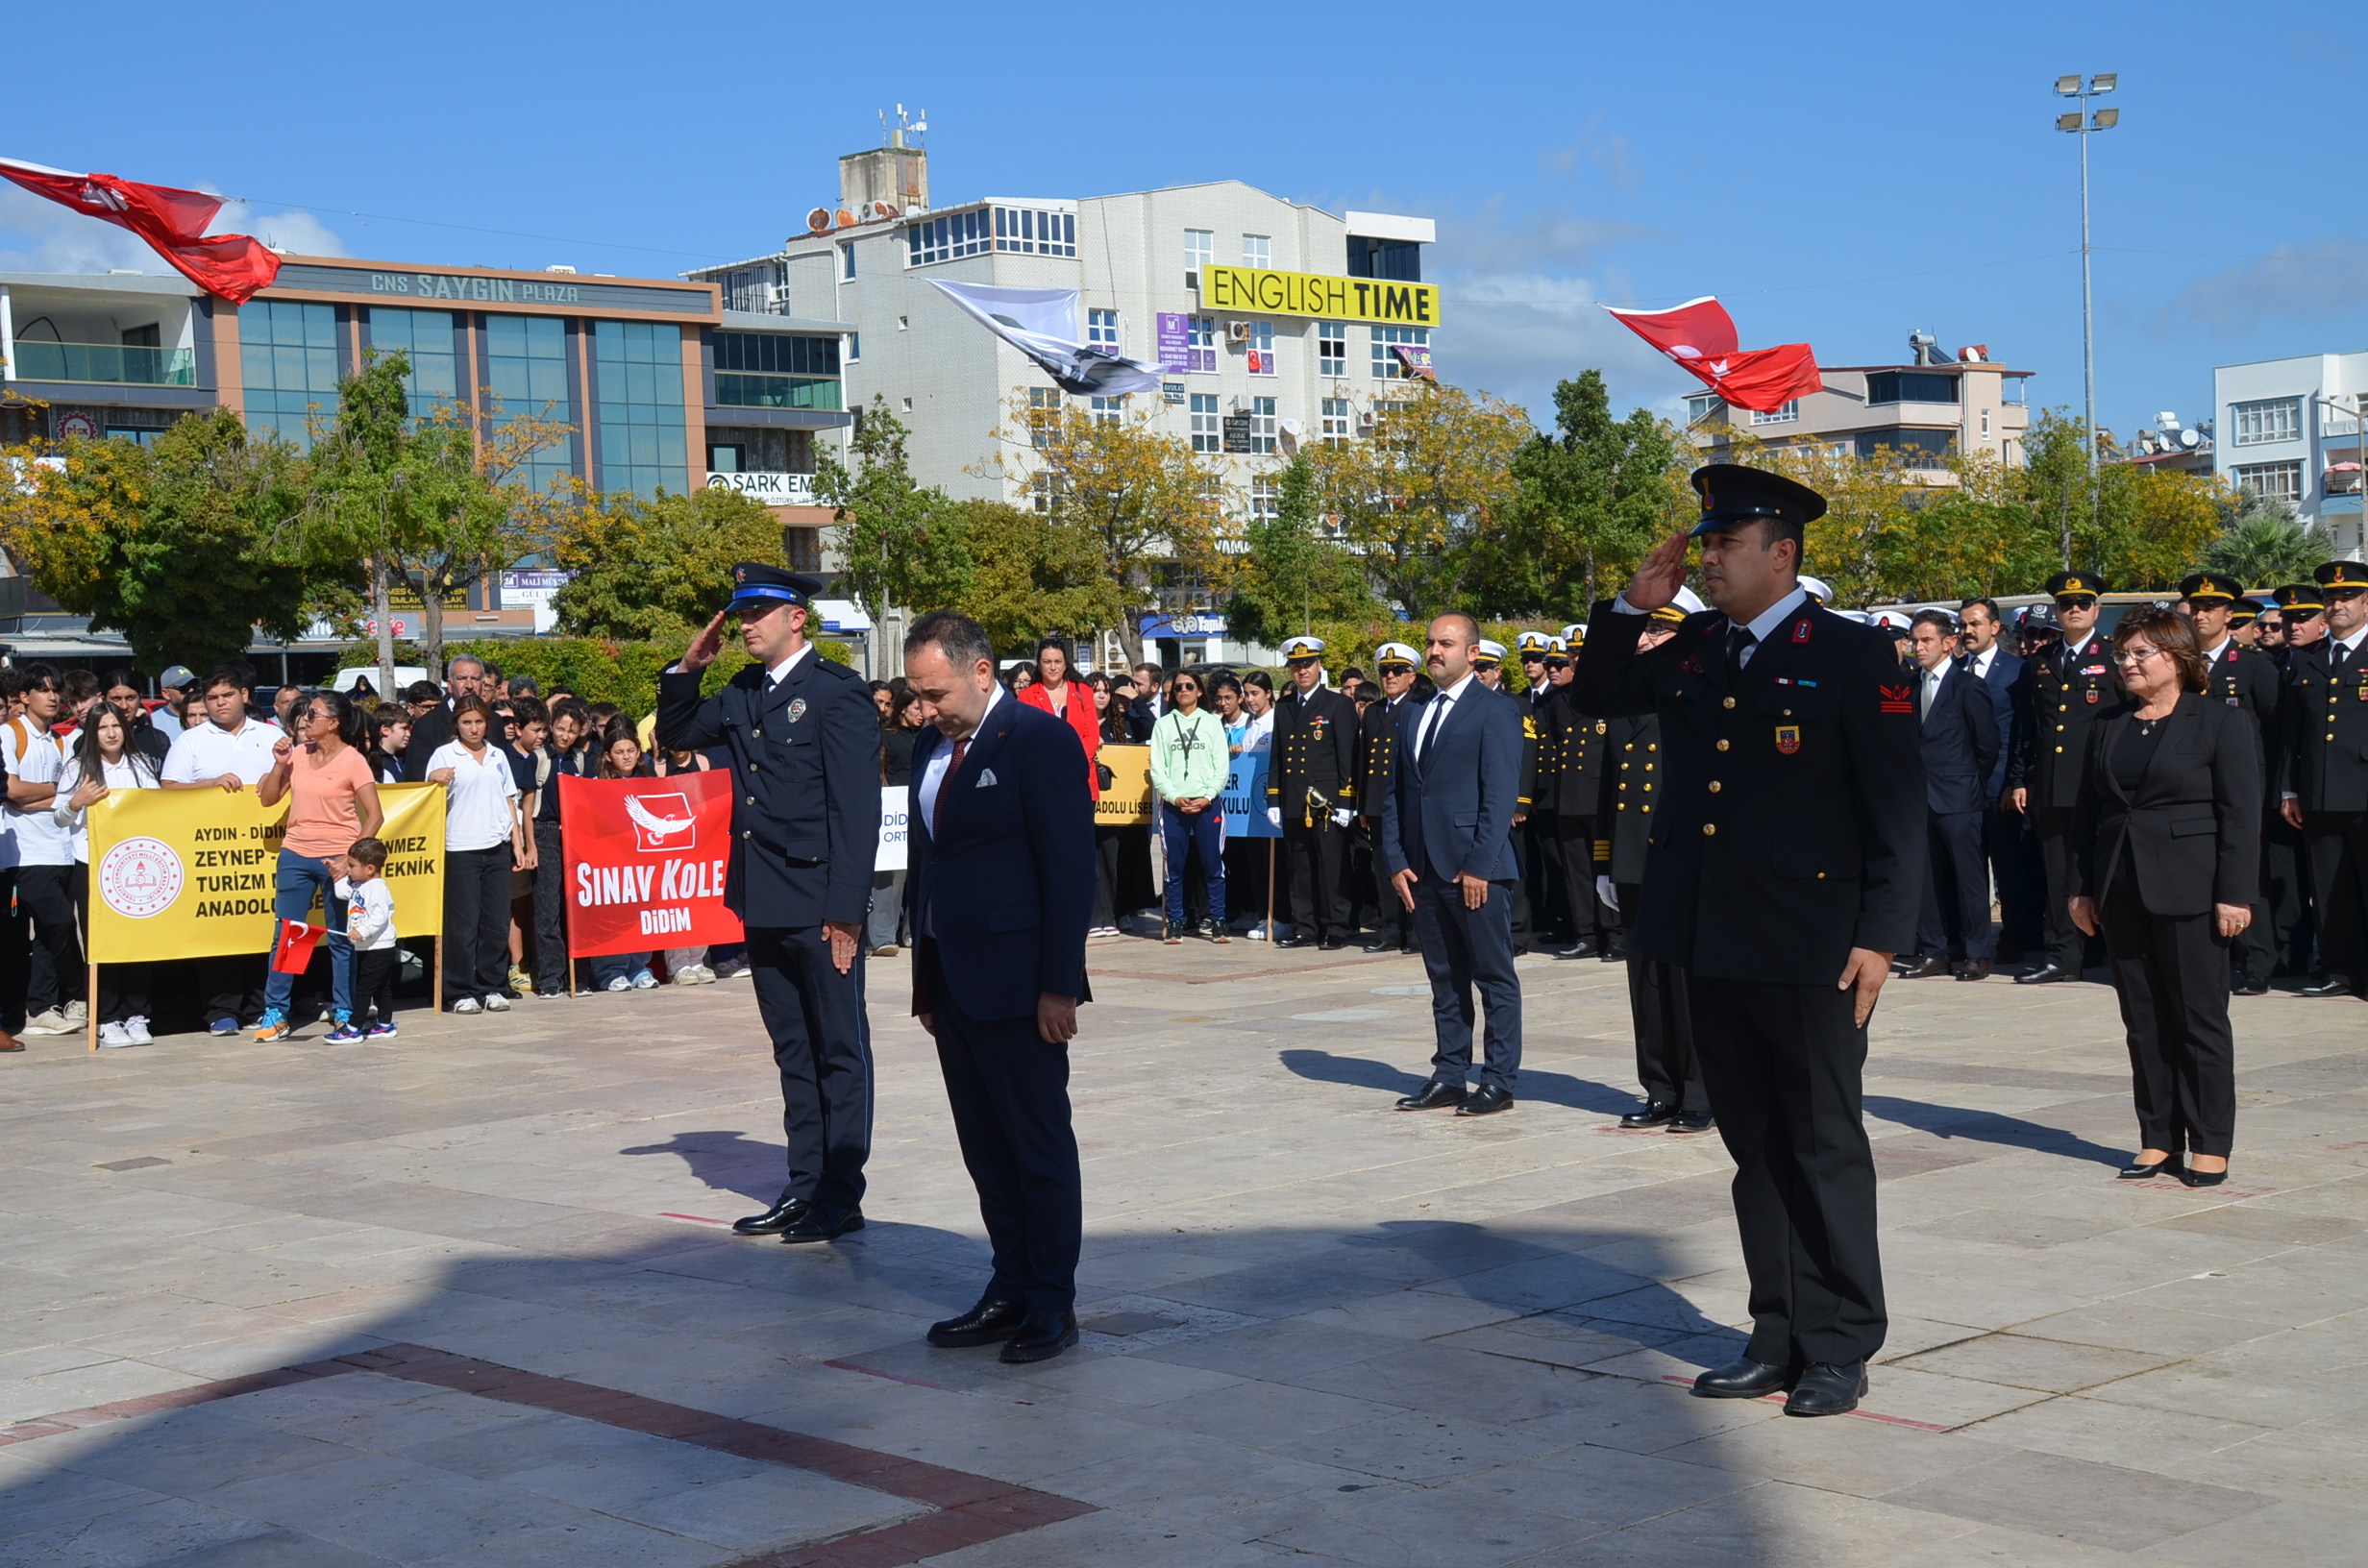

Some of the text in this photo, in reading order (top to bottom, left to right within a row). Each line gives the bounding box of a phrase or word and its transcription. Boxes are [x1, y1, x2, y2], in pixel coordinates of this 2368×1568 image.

[372, 274, 579, 303] CNS SAYGIN PLAZA
[1214, 269, 1430, 322] ENGLISH TIME
[521, 576, 541, 586] MALİ
[884, 811, 908, 827] DİD
[194, 825, 237, 843] AYDIN
[883, 830, 908, 843] ORT
[194, 847, 265, 868] ZEYNEP
[383, 836, 427, 854] NMEZ
[195, 870, 266, 894] TURİZM
